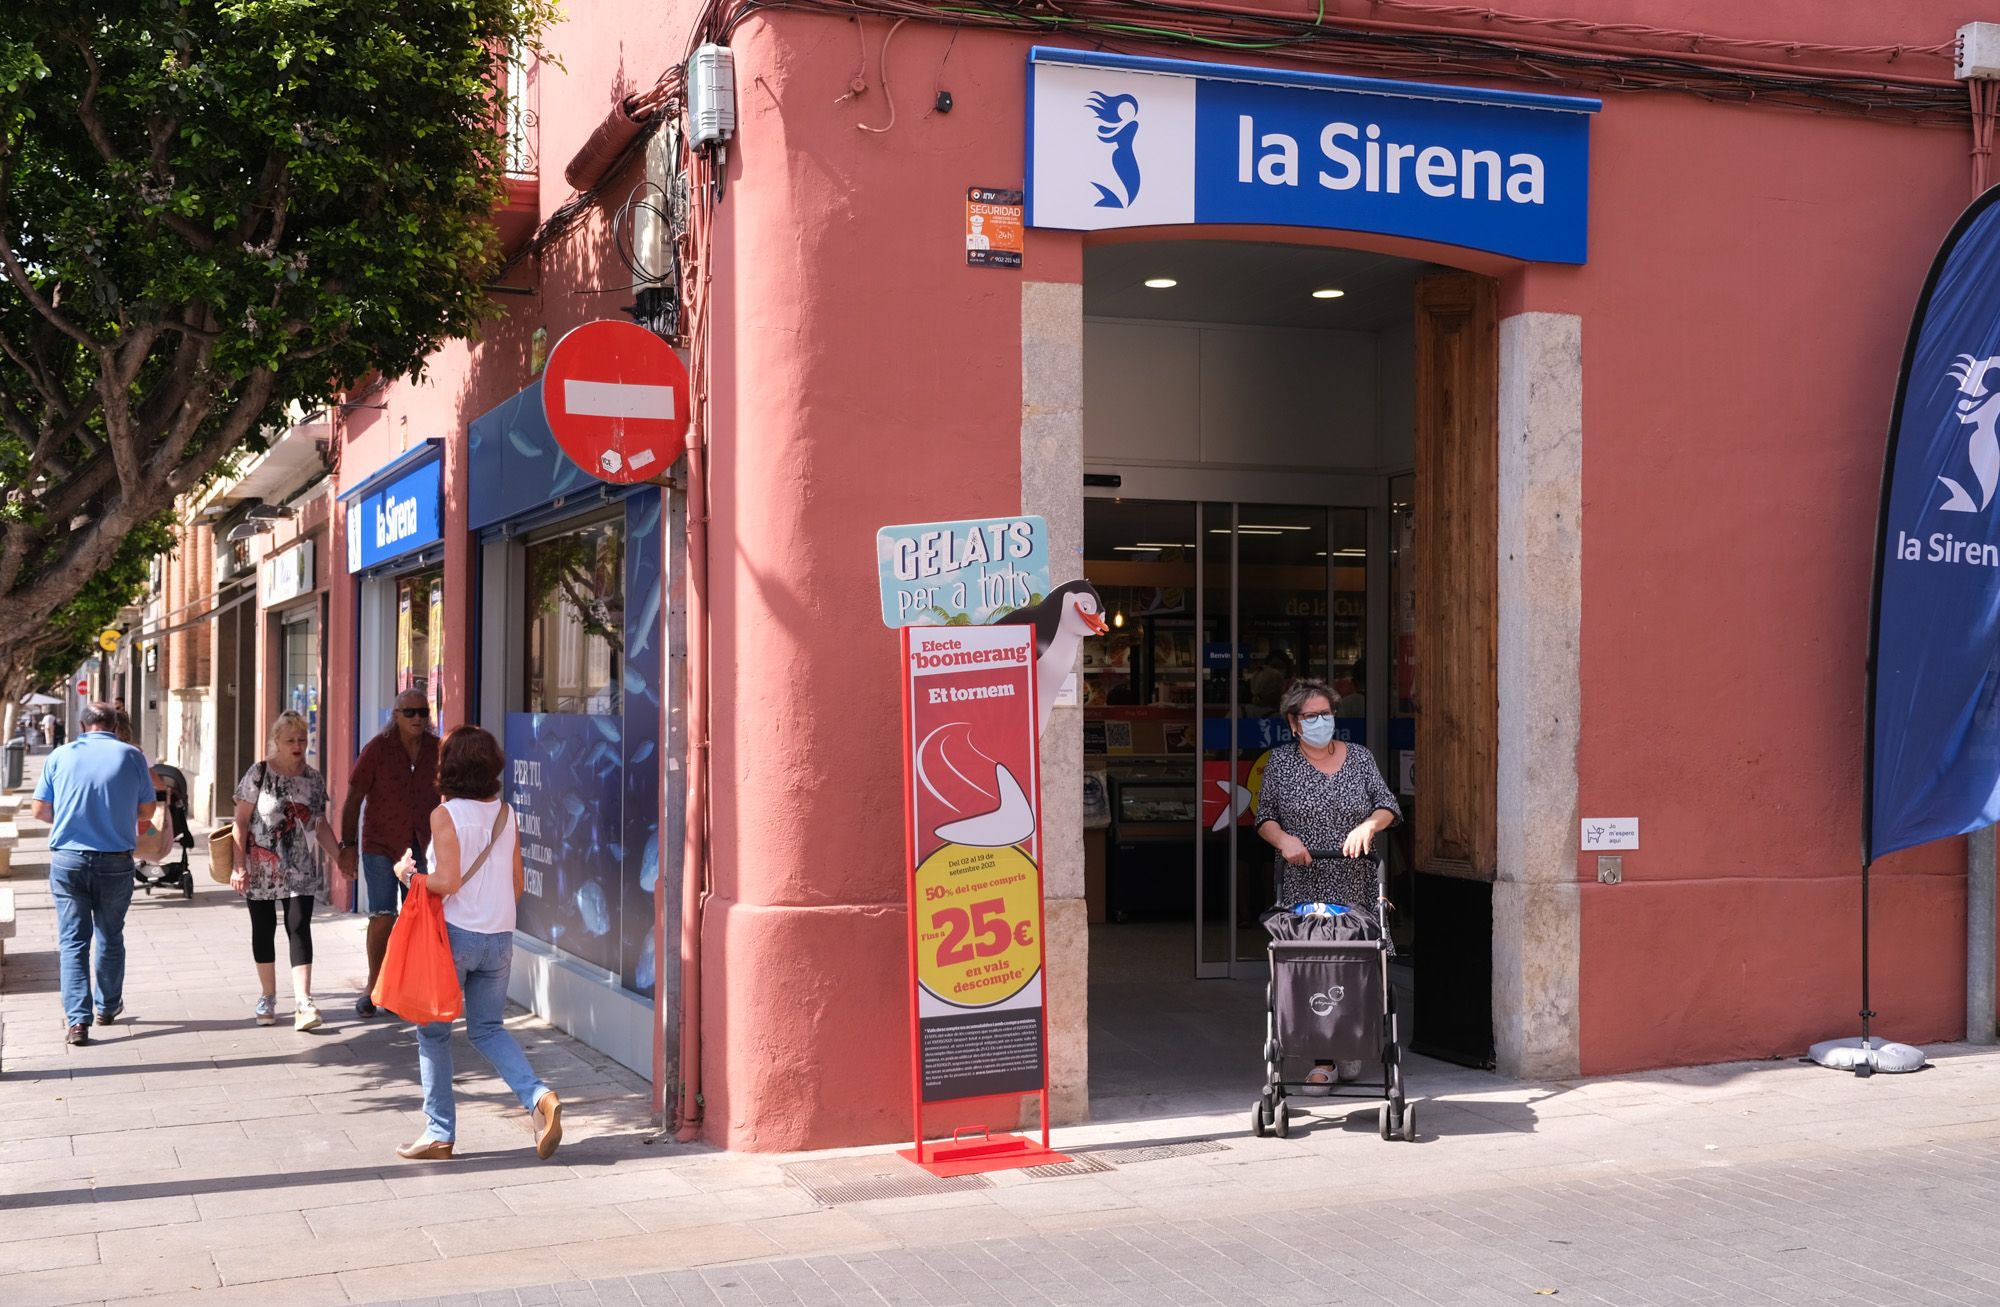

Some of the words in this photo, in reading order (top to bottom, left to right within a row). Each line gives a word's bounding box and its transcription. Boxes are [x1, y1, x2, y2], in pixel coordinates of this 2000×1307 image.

[1238, 114, 1298, 186] la
[1319, 122, 1544, 204] Sirena
[970, 204, 1020, 216] SEGURIDAD
[376, 504, 386, 548] la
[386, 496, 417, 544] Sirena
[894, 522, 1033, 581] GELATS
[1897, 530, 1922, 560] la
[898, 586, 941, 619] per
[952, 582, 967, 609] a
[978, 562, 1032, 609] tots
[922, 640, 962, 652] Efecte
[928, 688, 948, 704] Et
[950, 683, 1015, 702] tornem
[514, 760, 528, 784] PER
[529, 761, 542, 790] TU,
[531, 843, 552, 864] MILLOR
[949, 860, 960, 868] Del
[523, 866, 543, 898] IGEN
[949, 865, 980, 876] setembre
[981, 860, 996, 870] 2021
[926, 885, 954, 901] 50%
[955, 884, 970, 894] del
[971, 881, 988, 892] que
[989, 873, 1026, 886] compris
[966, 967, 982, 978] en
[984, 960, 1010, 973] vals
